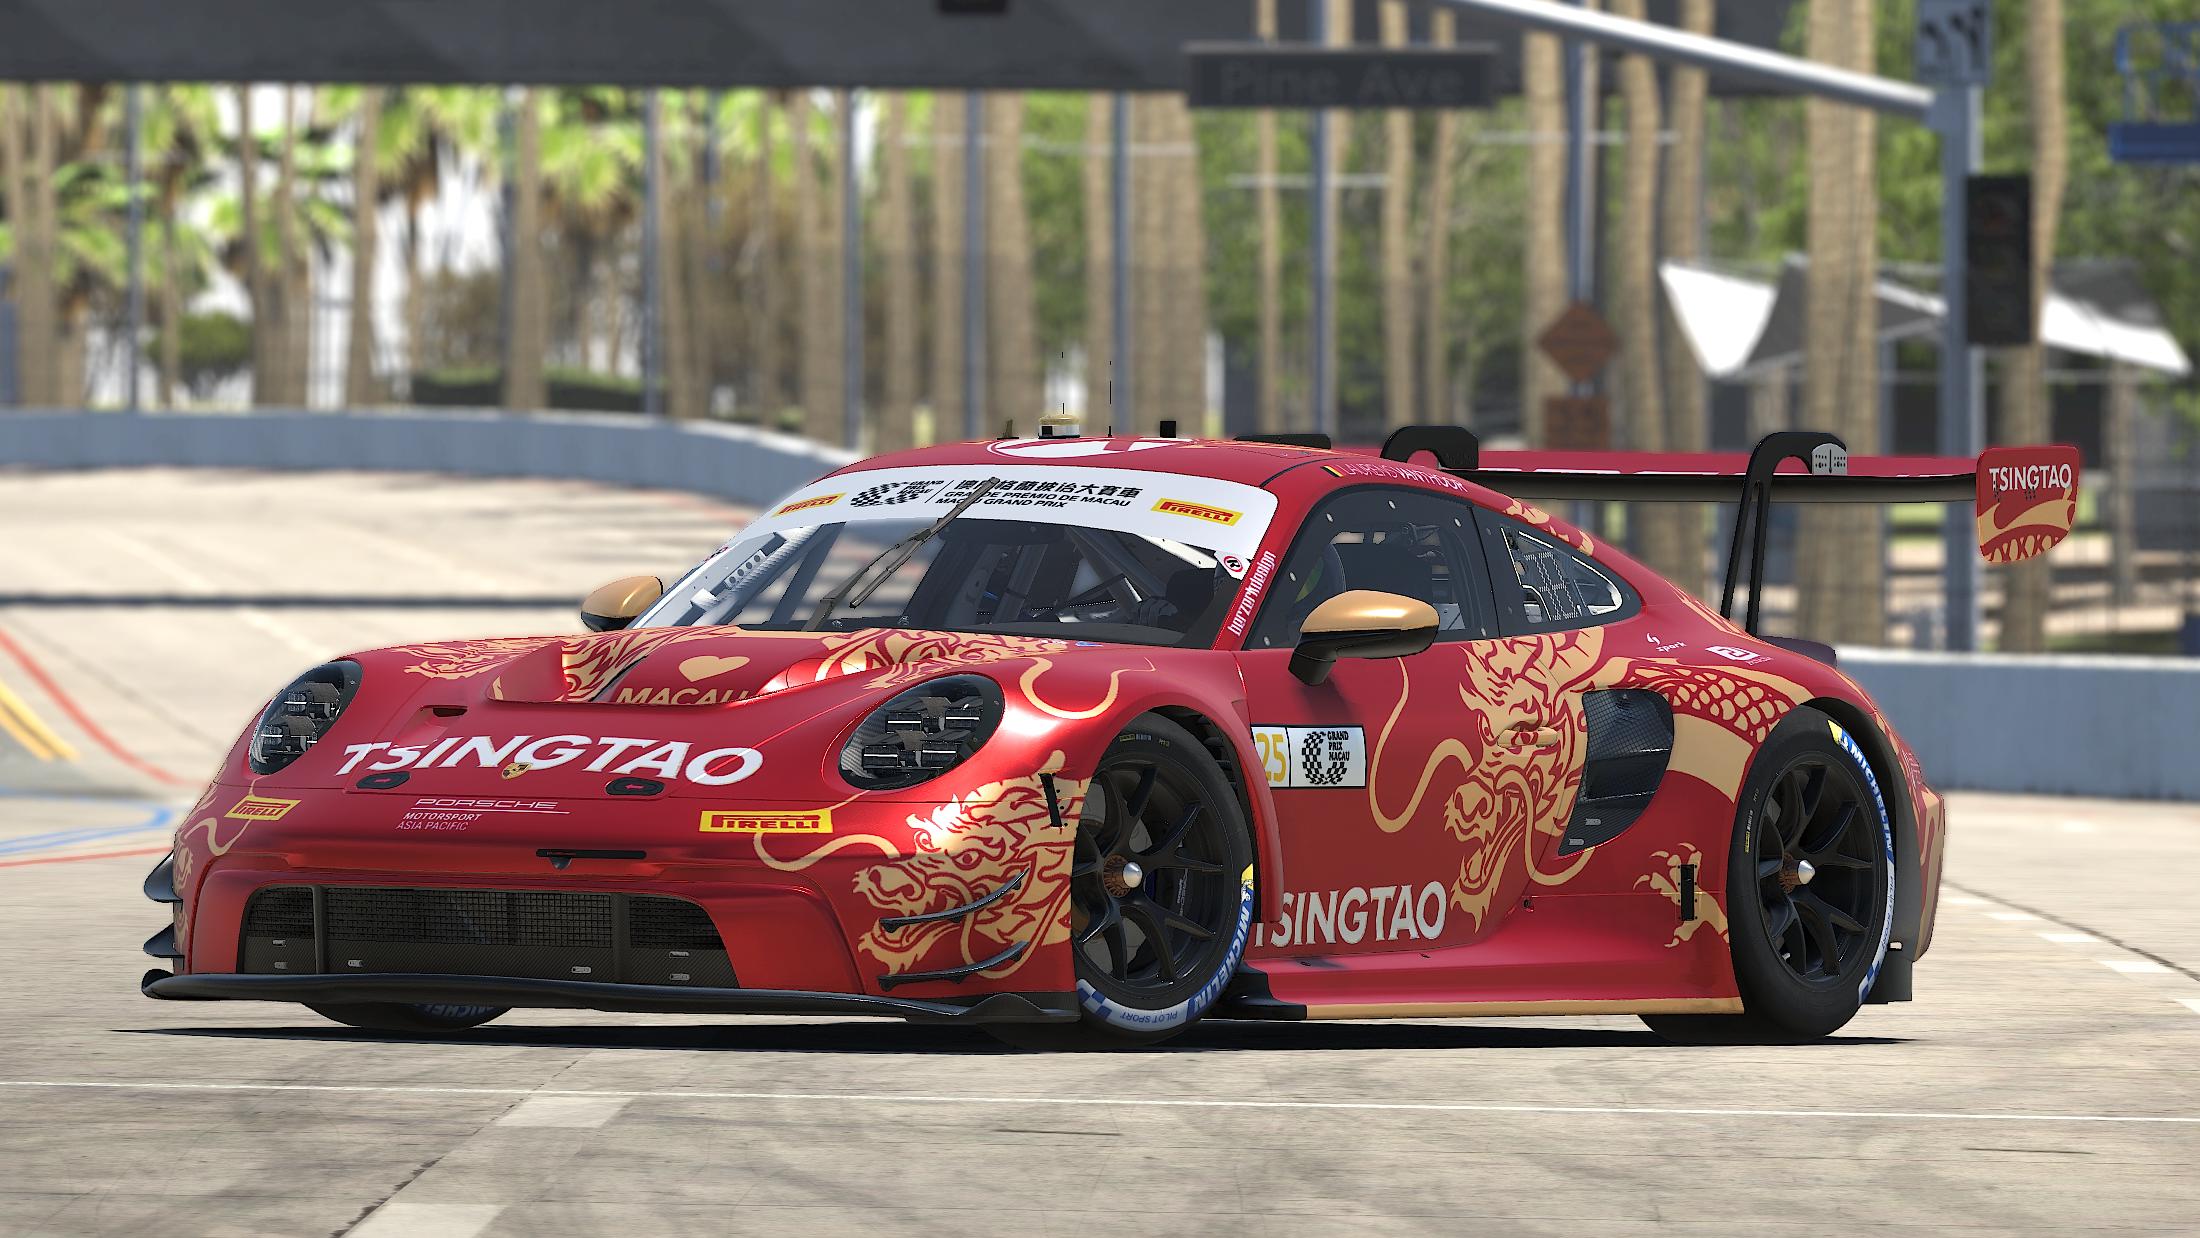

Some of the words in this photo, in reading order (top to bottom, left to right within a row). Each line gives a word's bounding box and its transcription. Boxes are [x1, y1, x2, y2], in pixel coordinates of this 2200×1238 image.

[1220, 60, 1339, 99] Pine
[1360, 60, 1465, 99] Ave
[1988, 463, 2072, 492] TSINGTAO
[984, 498, 1029, 506] GRAND
[1029, 500, 1068, 508] PRIX
[1058, 495, 1080, 503] DE
[1080, 497, 1131, 507] MACAU
[1160, 502, 1234, 522] PIRELLI
[1327, 730, 1349, 740] GRAND
[1328, 741, 1343, 751] PRIX
[333, 735, 764, 786] TSINGTAO
[1328, 751, 1350, 761] MACAU
[415, 798, 560, 809] PORSCHE
[1850, 743, 1893, 852] MICHELIN
[232, 801, 291, 816] PIRELLI
[402, 812, 483, 821] MOTORSPORT
[711, 814, 820, 829] PIRELLI
[396, 821, 422, 830] ASIA
[424, 821, 470, 831] PACIFIC
[1193, 906, 1250, 1014] MICHELIN
[1120, 1011, 1150, 1024] SPORT
[1152, 1010, 1178, 1023] PILOT
